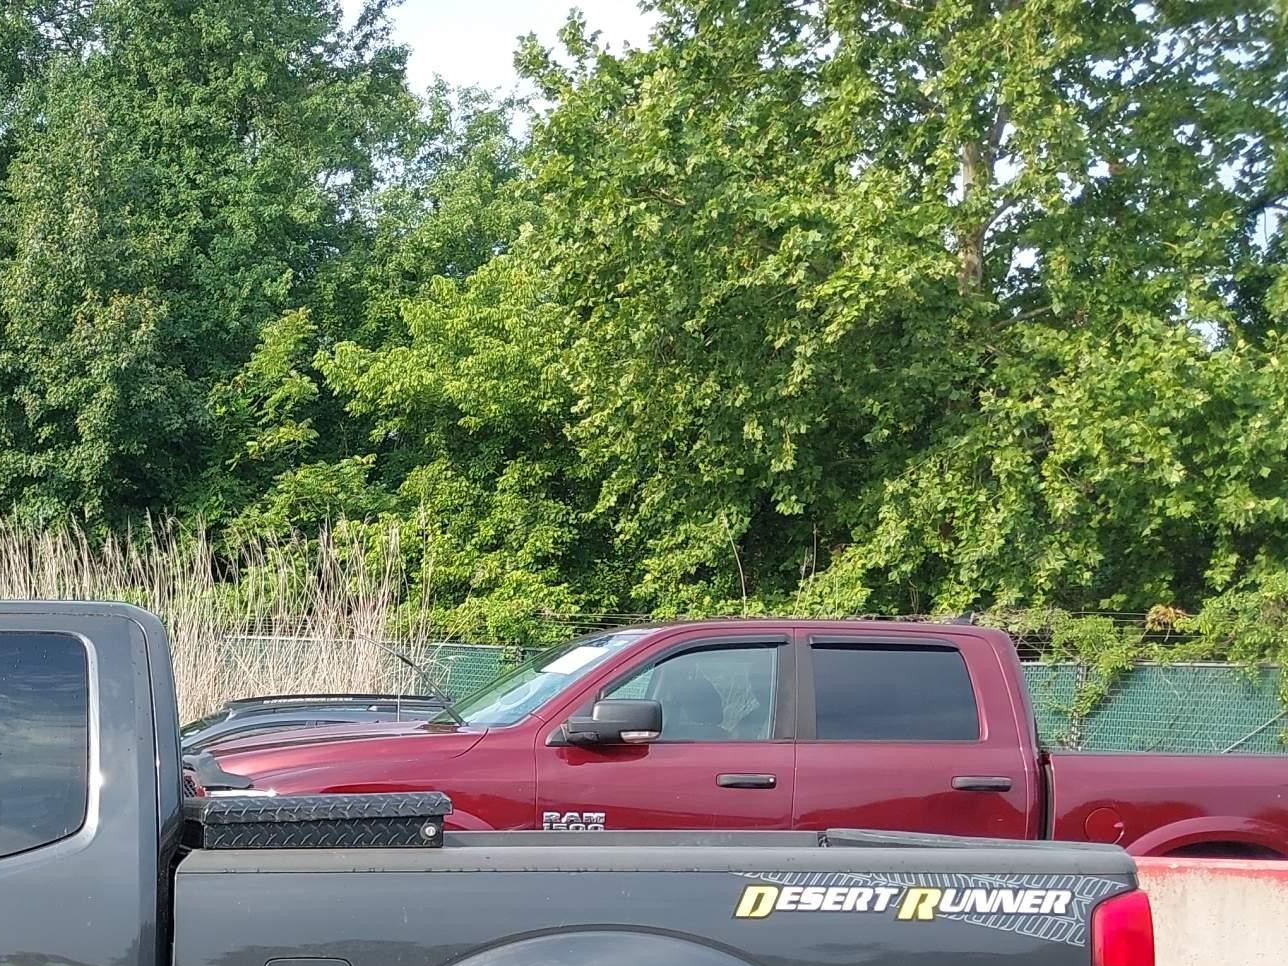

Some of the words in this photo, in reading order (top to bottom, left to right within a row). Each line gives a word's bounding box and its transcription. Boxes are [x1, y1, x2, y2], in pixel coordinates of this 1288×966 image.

[543, 812, 605, 823] RAM
[734, 885, 899, 919] DESERT
[896, 887, 1072, 920] RUNNER
